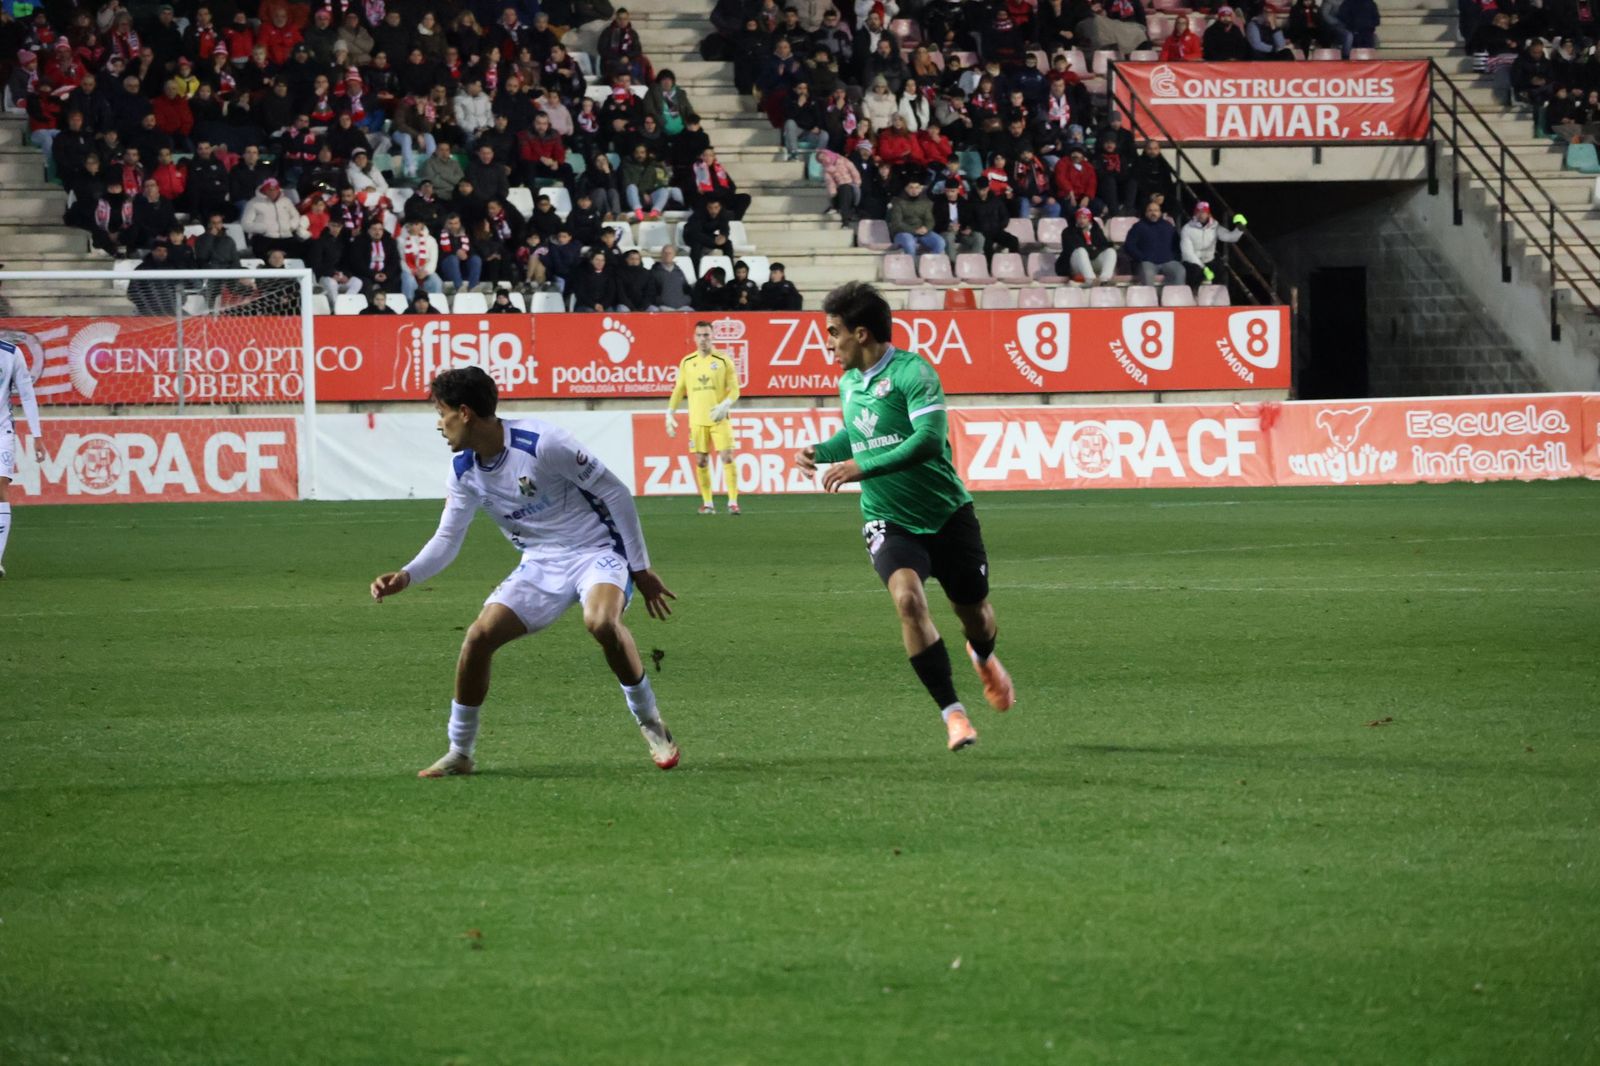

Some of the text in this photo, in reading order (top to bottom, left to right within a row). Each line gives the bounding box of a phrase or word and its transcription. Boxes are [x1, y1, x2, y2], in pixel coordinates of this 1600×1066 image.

[1205, 99, 1395, 138] TAMAR, S.A.
[90, 339, 363, 373] CENTRO ÓPTCO
[422, 320, 523, 367] fisio
[1035, 321, 1058, 361] 8
[1140, 319, 1163, 360] 8
[1246, 318, 1269, 357] 8
[552, 360, 679, 394] podoactiva
[1003, 340, 1044, 387] ZAMORA
[1108, 338, 1149, 386] ZAMORA
[1215, 337, 1255, 385] ZAMORA
[153, 372, 304, 399] ROBERTO
[625, 383, 675, 393] BIOMECÁNIC
[867, 433, 904, 449] RURAL
[1406, 405, 1571, 438] Escuela
[9, 431, 286, 496] AMORA CF
[964, 418, 1262, 480] ZAMORA CF
[1411, 441, 1572, 476] infantil
